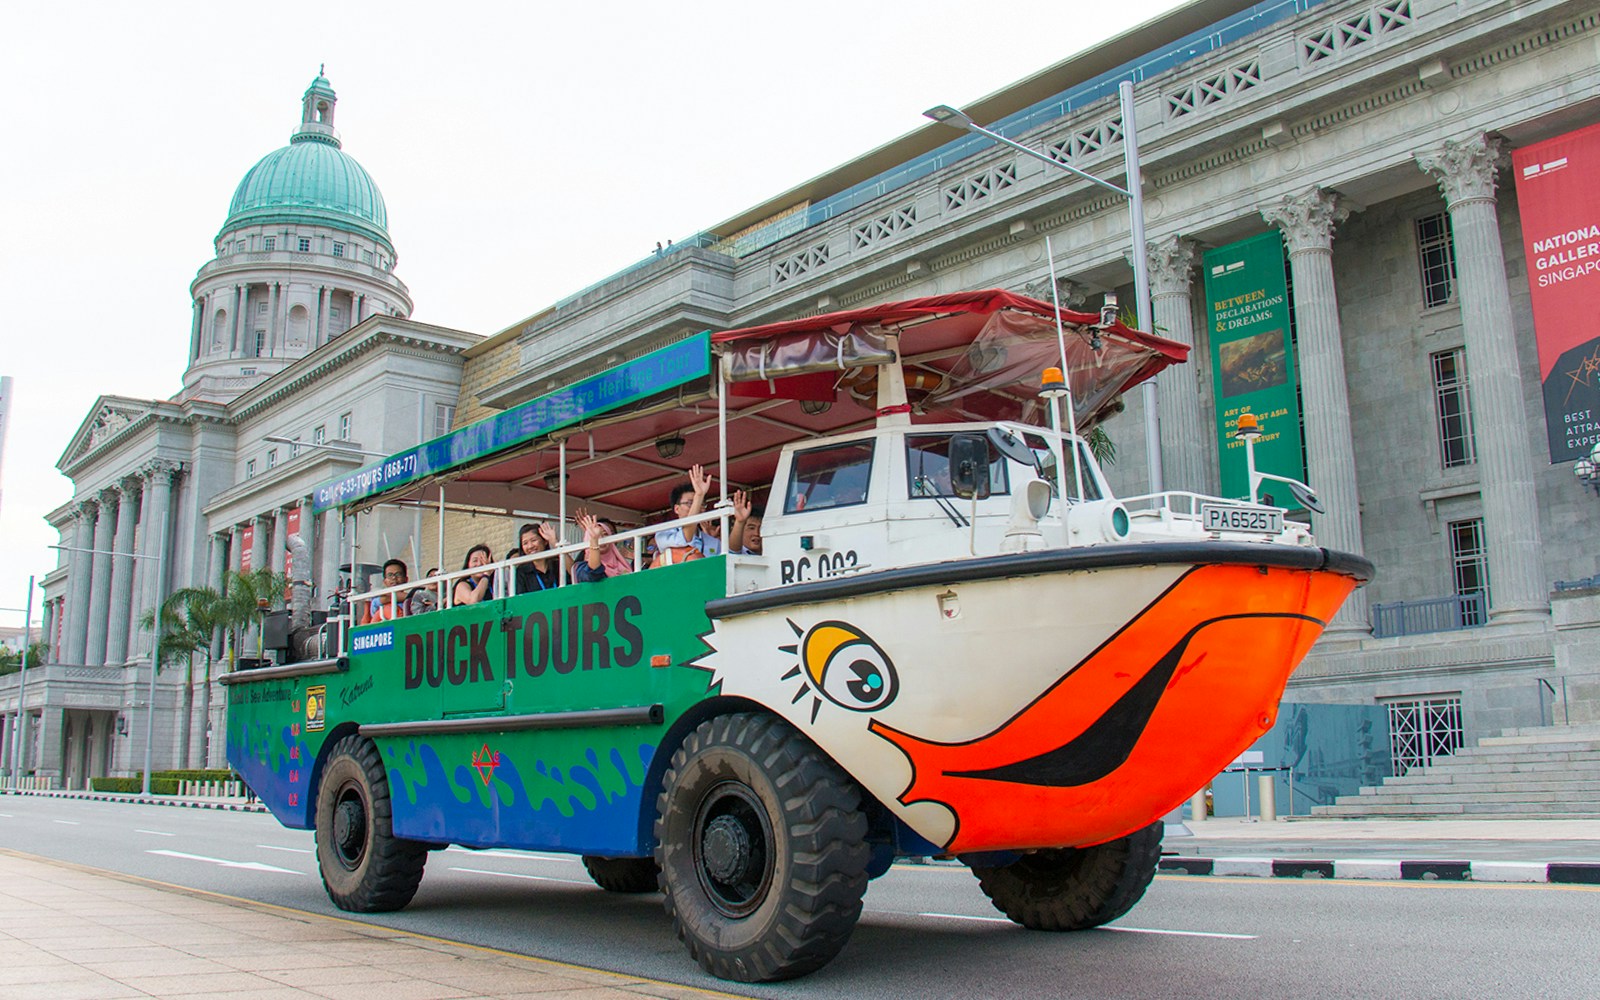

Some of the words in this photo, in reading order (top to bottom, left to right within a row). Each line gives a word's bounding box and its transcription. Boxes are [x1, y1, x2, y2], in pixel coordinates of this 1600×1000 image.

[1533, 225, 1600, 254] NATIONA
[1536, 242, 1600, 270] GALLER
[1215, 288, 1265, 311] BETWEEN
[1215, 295, 1283, 321] DECLARATIONS
[1216, 321, 1226, 332] &
[1228, 310, 1273, 329] DREAMS:
[599, 366, 653, 400] Heritage
[658, 351, 690, 376] Tour
[1224, 408, 1239, 417] ART
[1240, 405, 1251, 413] OF
[1270, 408, 1288, 418] ASIA
[1564, 410, 1591, 423] BEST
[1251, 432, 1280, 444] ENTURY
[340, 466, 382, 496] 6-33-TOURS
[384, 453, 418, 483] (868-77)
[1209, 510, 1277, 530] PA6525T
[353, 632, 392, 651] SINGAPORE
[405, 621, 494, 689] DUCK
[501, 595, 644, 679] TOURS
